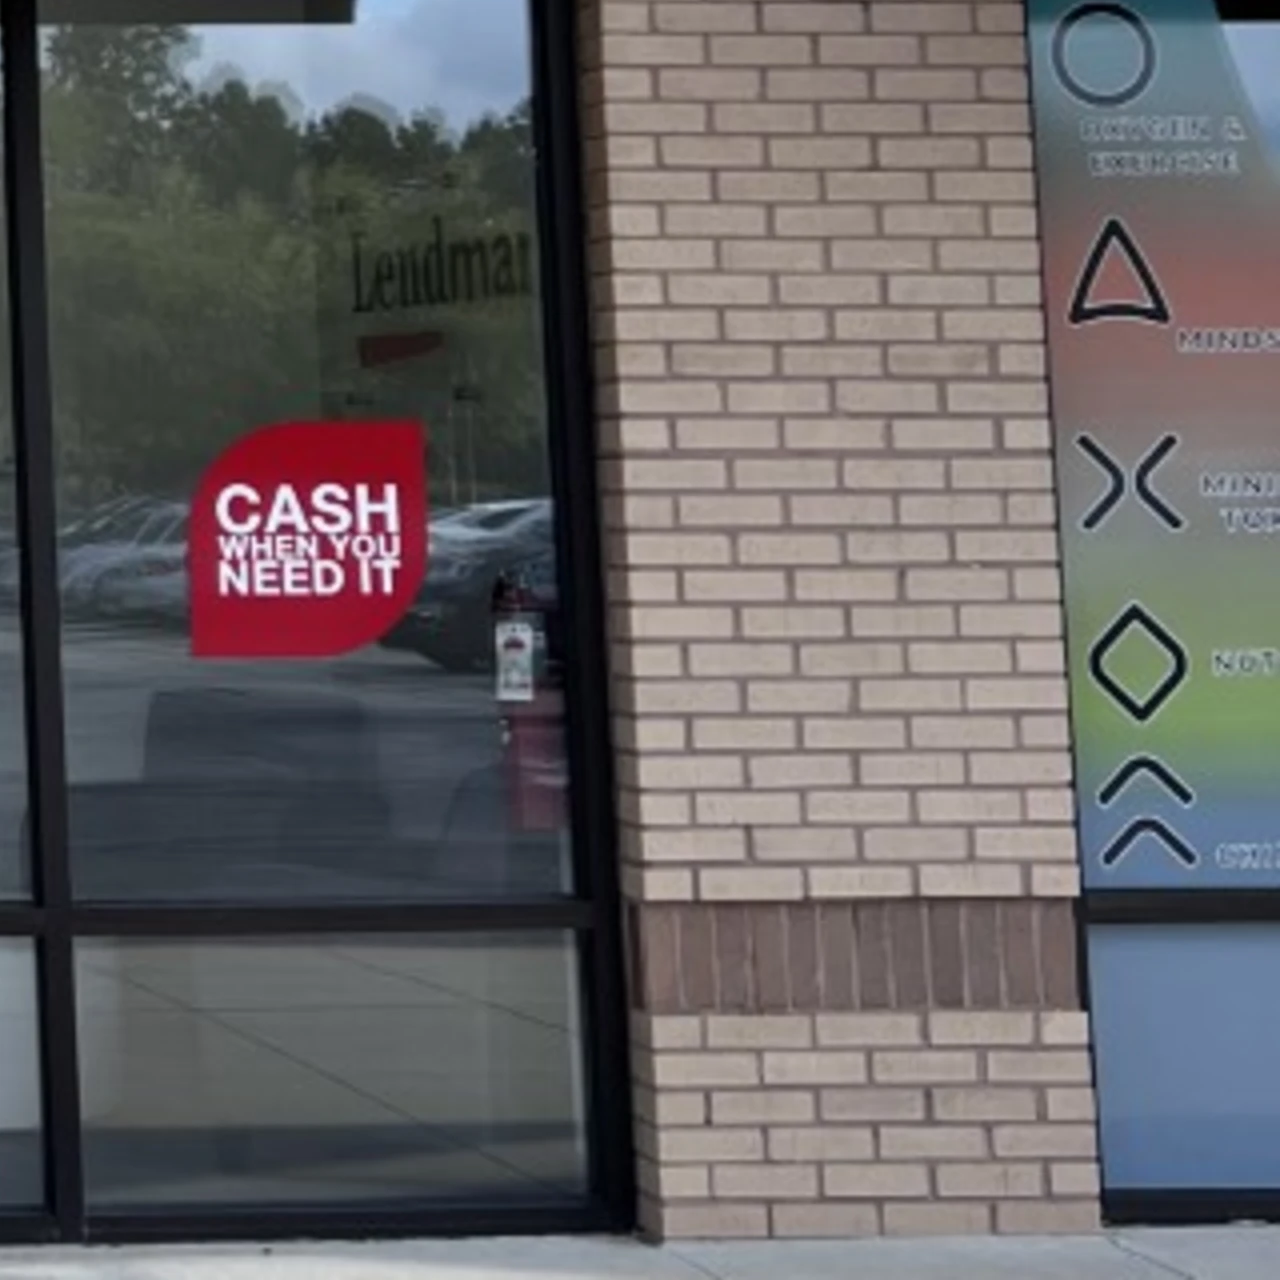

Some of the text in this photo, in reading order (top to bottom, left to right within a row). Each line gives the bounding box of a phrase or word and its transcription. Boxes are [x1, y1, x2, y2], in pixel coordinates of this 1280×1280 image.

[215, 483, 400, 534] CASH
[218, 535, 401, 560] WHEN YOU
[218, 560, 401, 597] NEED IT
